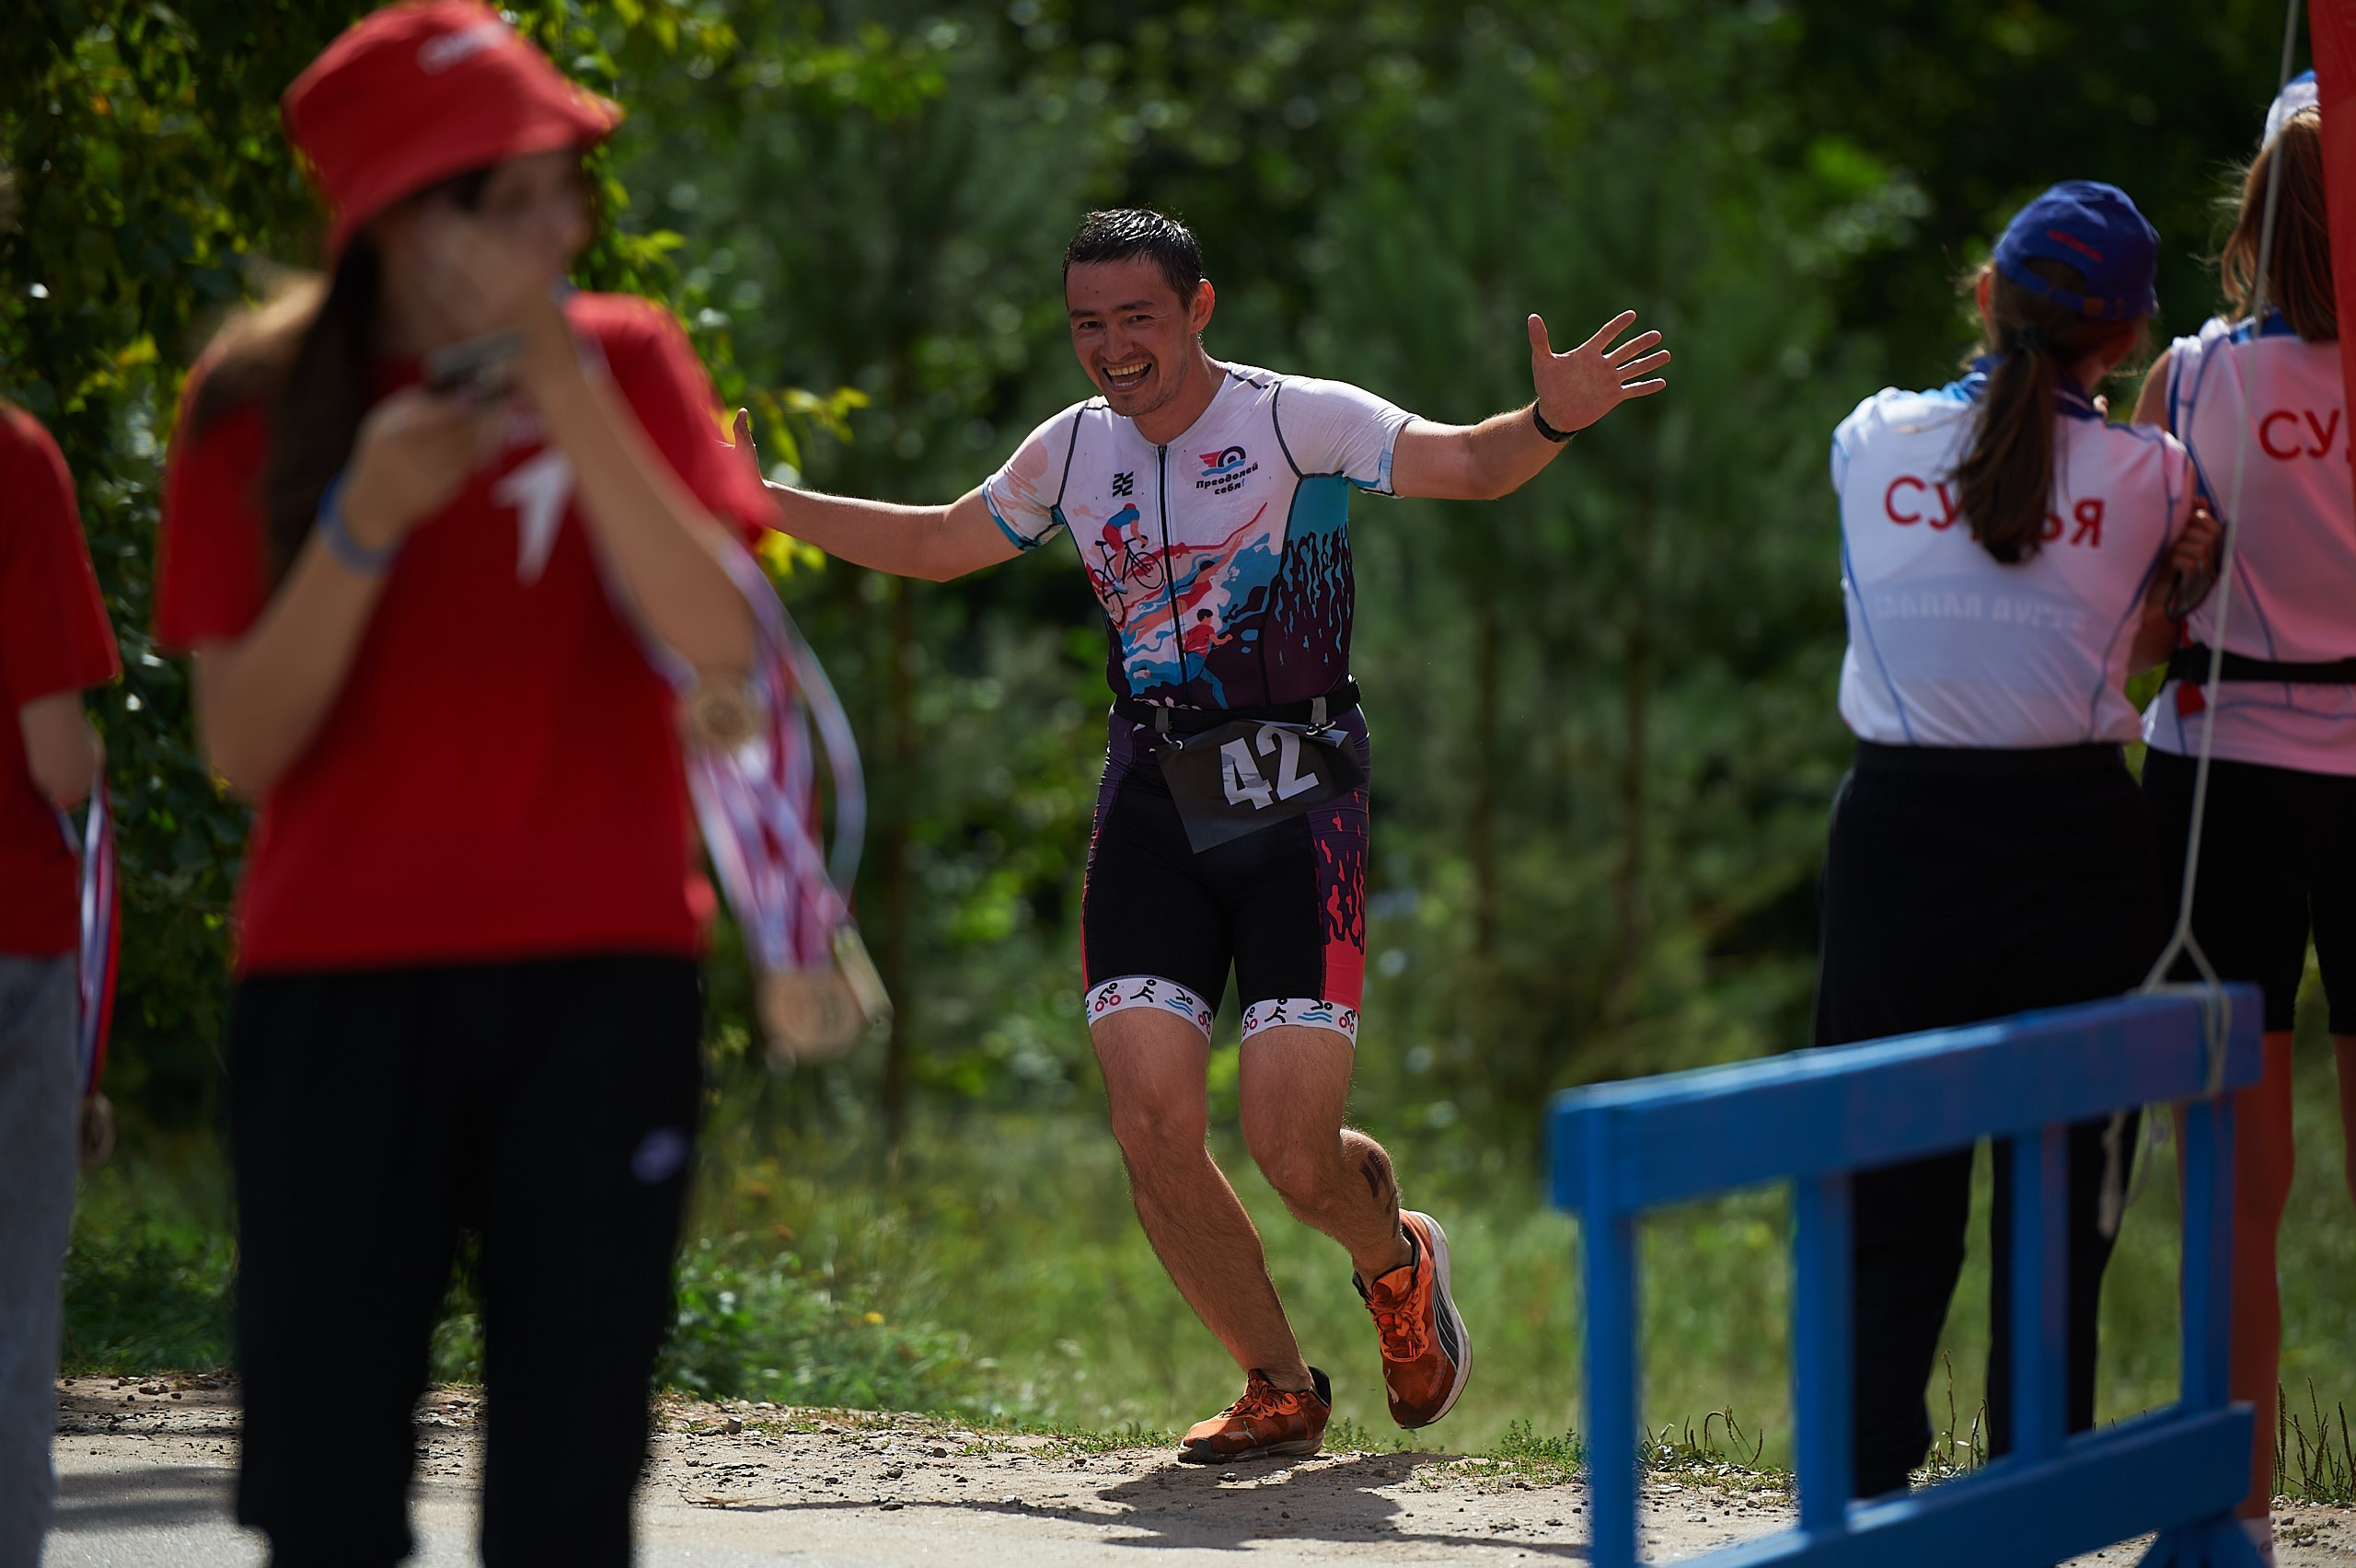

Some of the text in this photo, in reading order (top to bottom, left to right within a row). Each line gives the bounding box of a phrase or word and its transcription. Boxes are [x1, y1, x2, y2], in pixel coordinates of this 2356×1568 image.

[1195, 461, 1259, 490] Преодолей
[1214, 478, 1245, 495] себя!
[1220, 724, 1321, 811] 42
